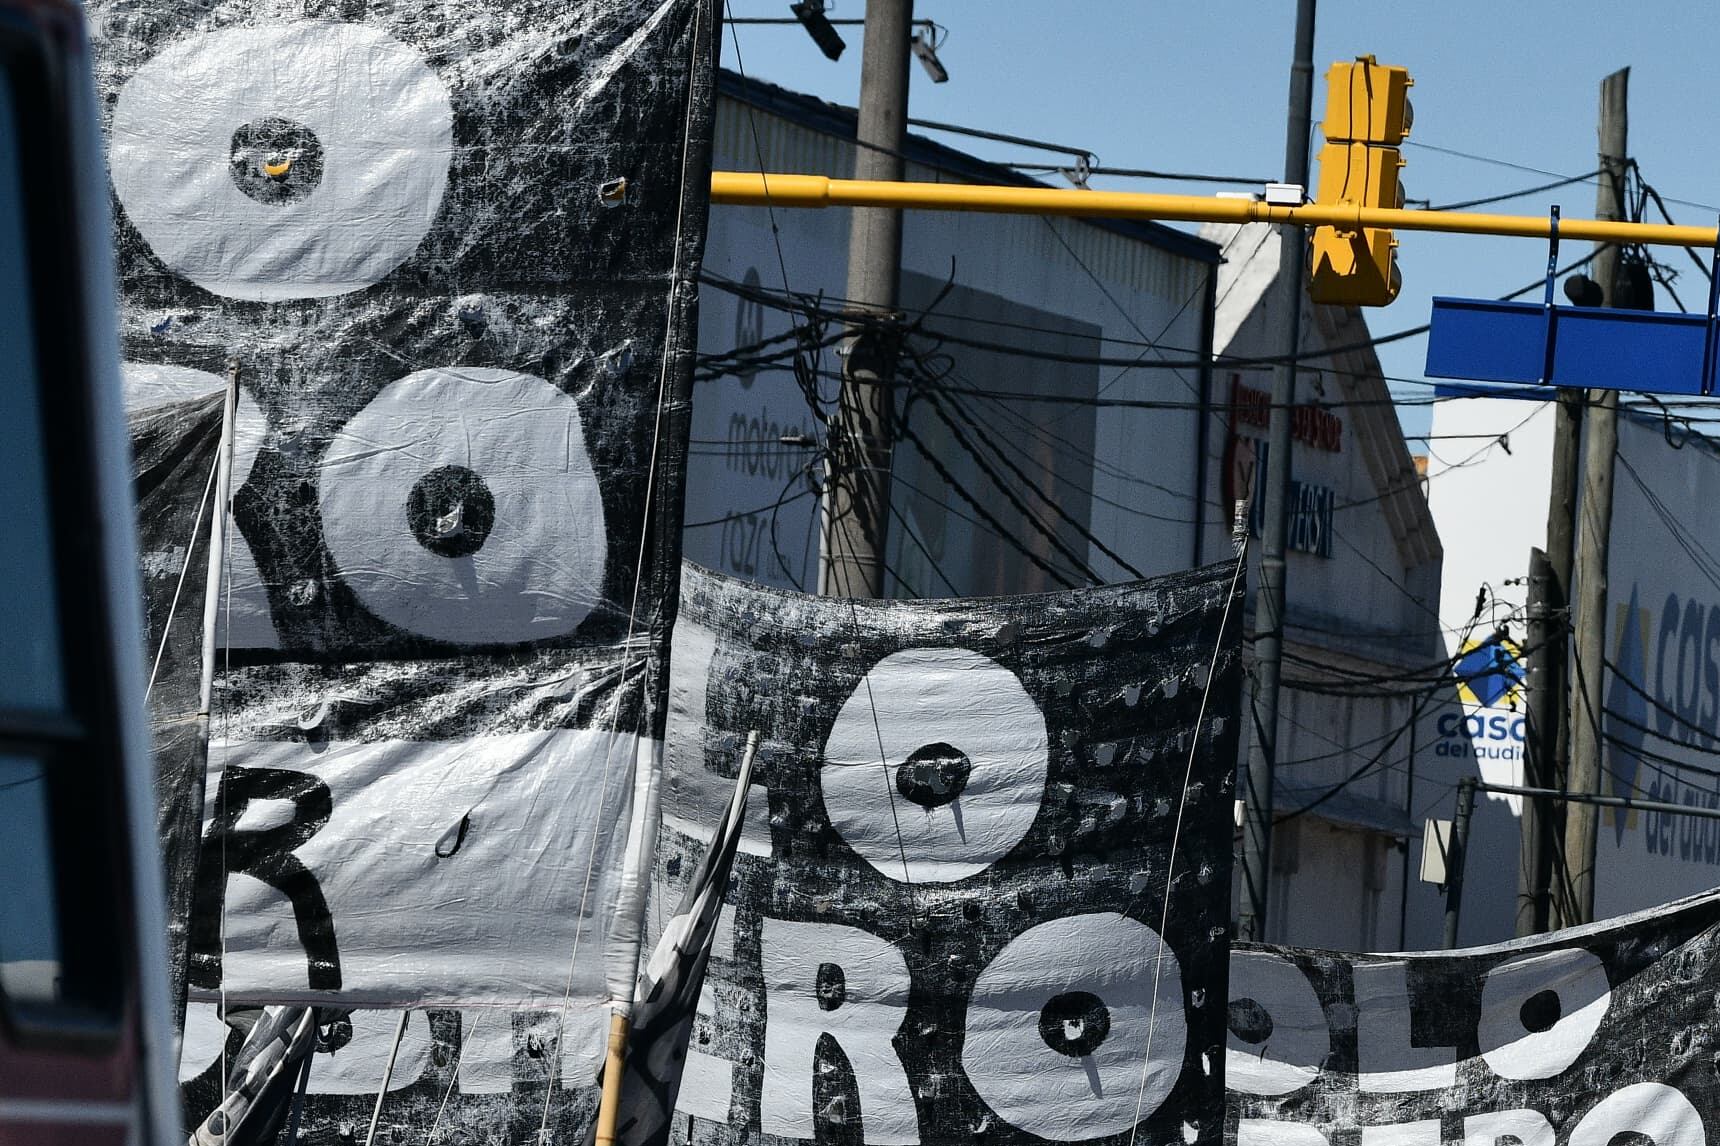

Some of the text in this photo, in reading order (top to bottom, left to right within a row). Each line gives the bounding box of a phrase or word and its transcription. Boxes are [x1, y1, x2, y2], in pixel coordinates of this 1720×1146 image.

[1435, 740, 1526, 761] del audi
[1645, 764, 1680, 858] del
